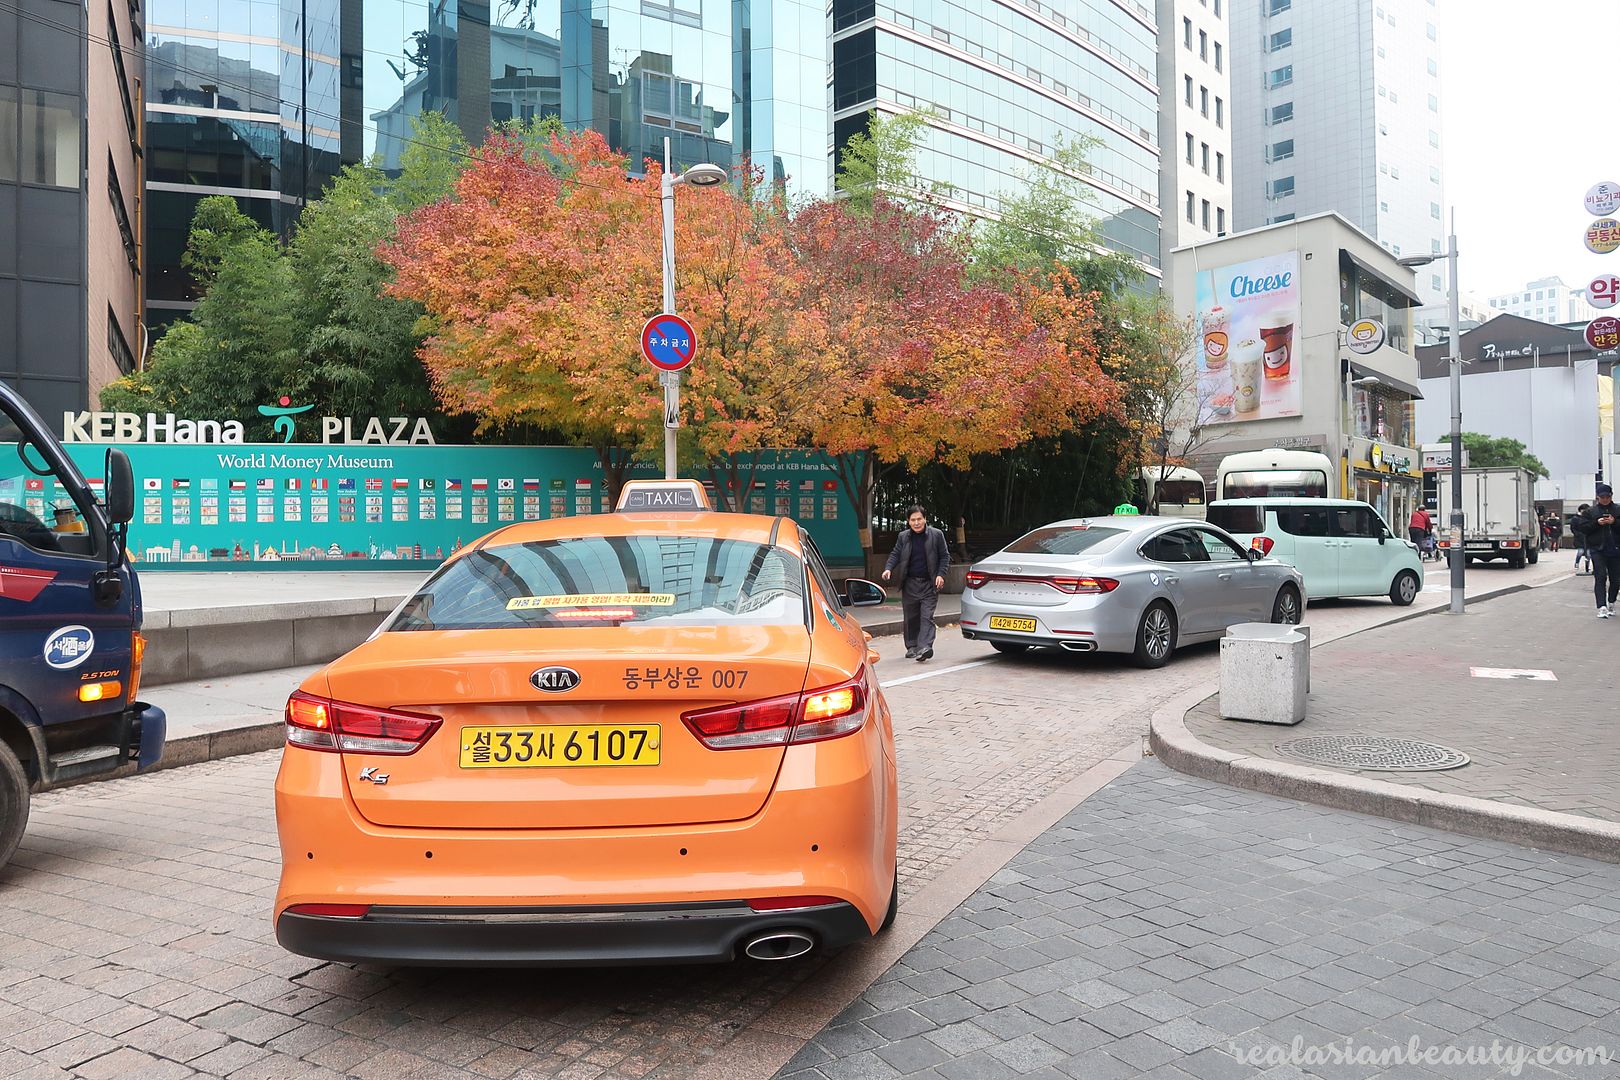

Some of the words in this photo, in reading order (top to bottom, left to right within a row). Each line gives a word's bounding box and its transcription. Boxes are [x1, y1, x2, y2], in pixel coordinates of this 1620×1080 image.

[1230, 271, 1292, 298] Cheese
[1590, 278, 1620, 304] 약
[649, 337, 689, 348] 주차금지
[1594, 333, 1618, 347] 안경
[321, 416, 436, 445] PLAZA
[217, 453, 267, 469] World
[270, 454, 323, 473] Money
[326, 454, 394, 469] Museum
[592, 461, 602, 469] All
[786, 462, 800, 470] KEB
[645, 491, 678, 506] TAXI
[1013, 619, 1032, 629] 5754
[537, 671, 575, 688] KIA
[622, 667, 703, 691] 동부상운
[712, 669, 749, 689] 007
[563, 729, 648, 762] 6107
[359, 766, 391, 785] K5
